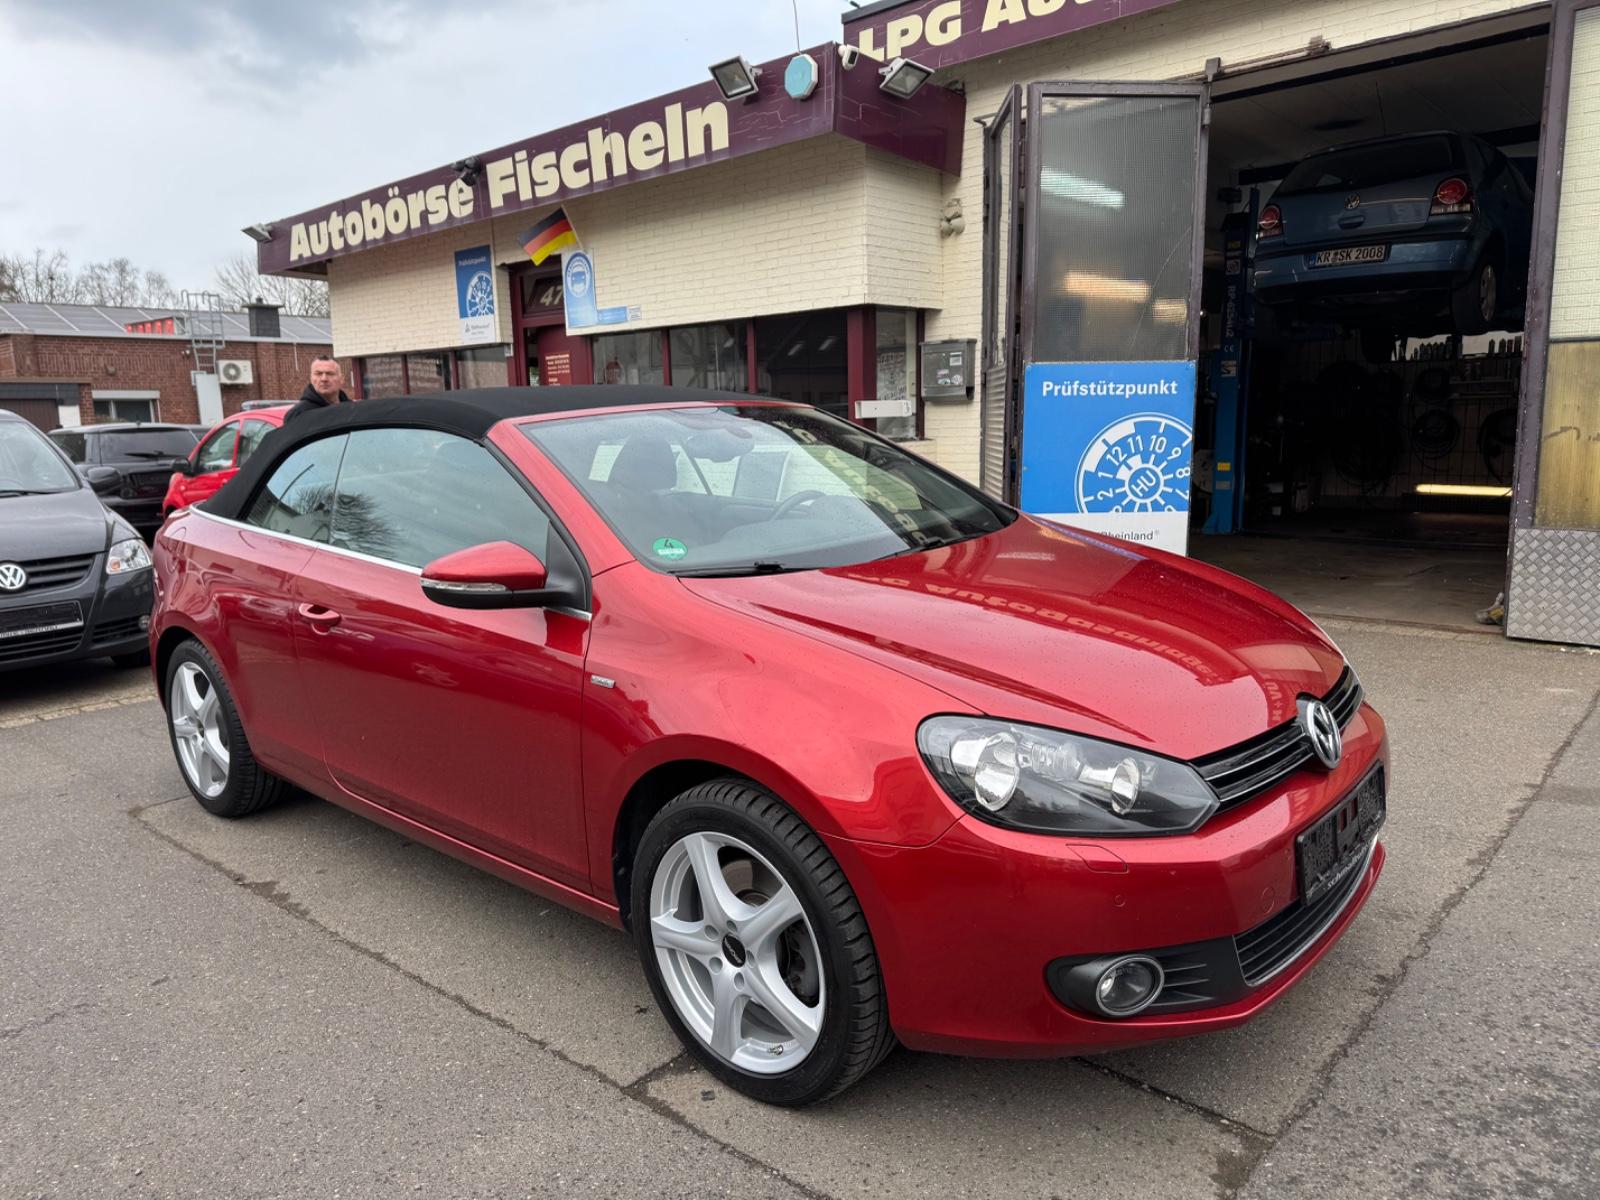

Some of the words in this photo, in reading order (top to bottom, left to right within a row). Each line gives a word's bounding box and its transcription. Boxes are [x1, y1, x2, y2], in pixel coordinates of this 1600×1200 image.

[859, 0, 962, 62] LPG
[289, 176, 475, 262] Autobörse
[485, 100, 729, 208] Fischeln
[1354, 246, 1383, 260] 2008
[540, 286, 563, 306] 47
[1042, 379, 1178, 398] Prüfstützpunkt
[1127, 435, 1143, 453] 11
[1149, 435, 1167, 454] 10
[1166, 447, 1182, 460] 9
[1106, 446, 1127, 466] 12
[1175, 466, 1191, 478] 8
[1131, 470, 1156, 497] HU
